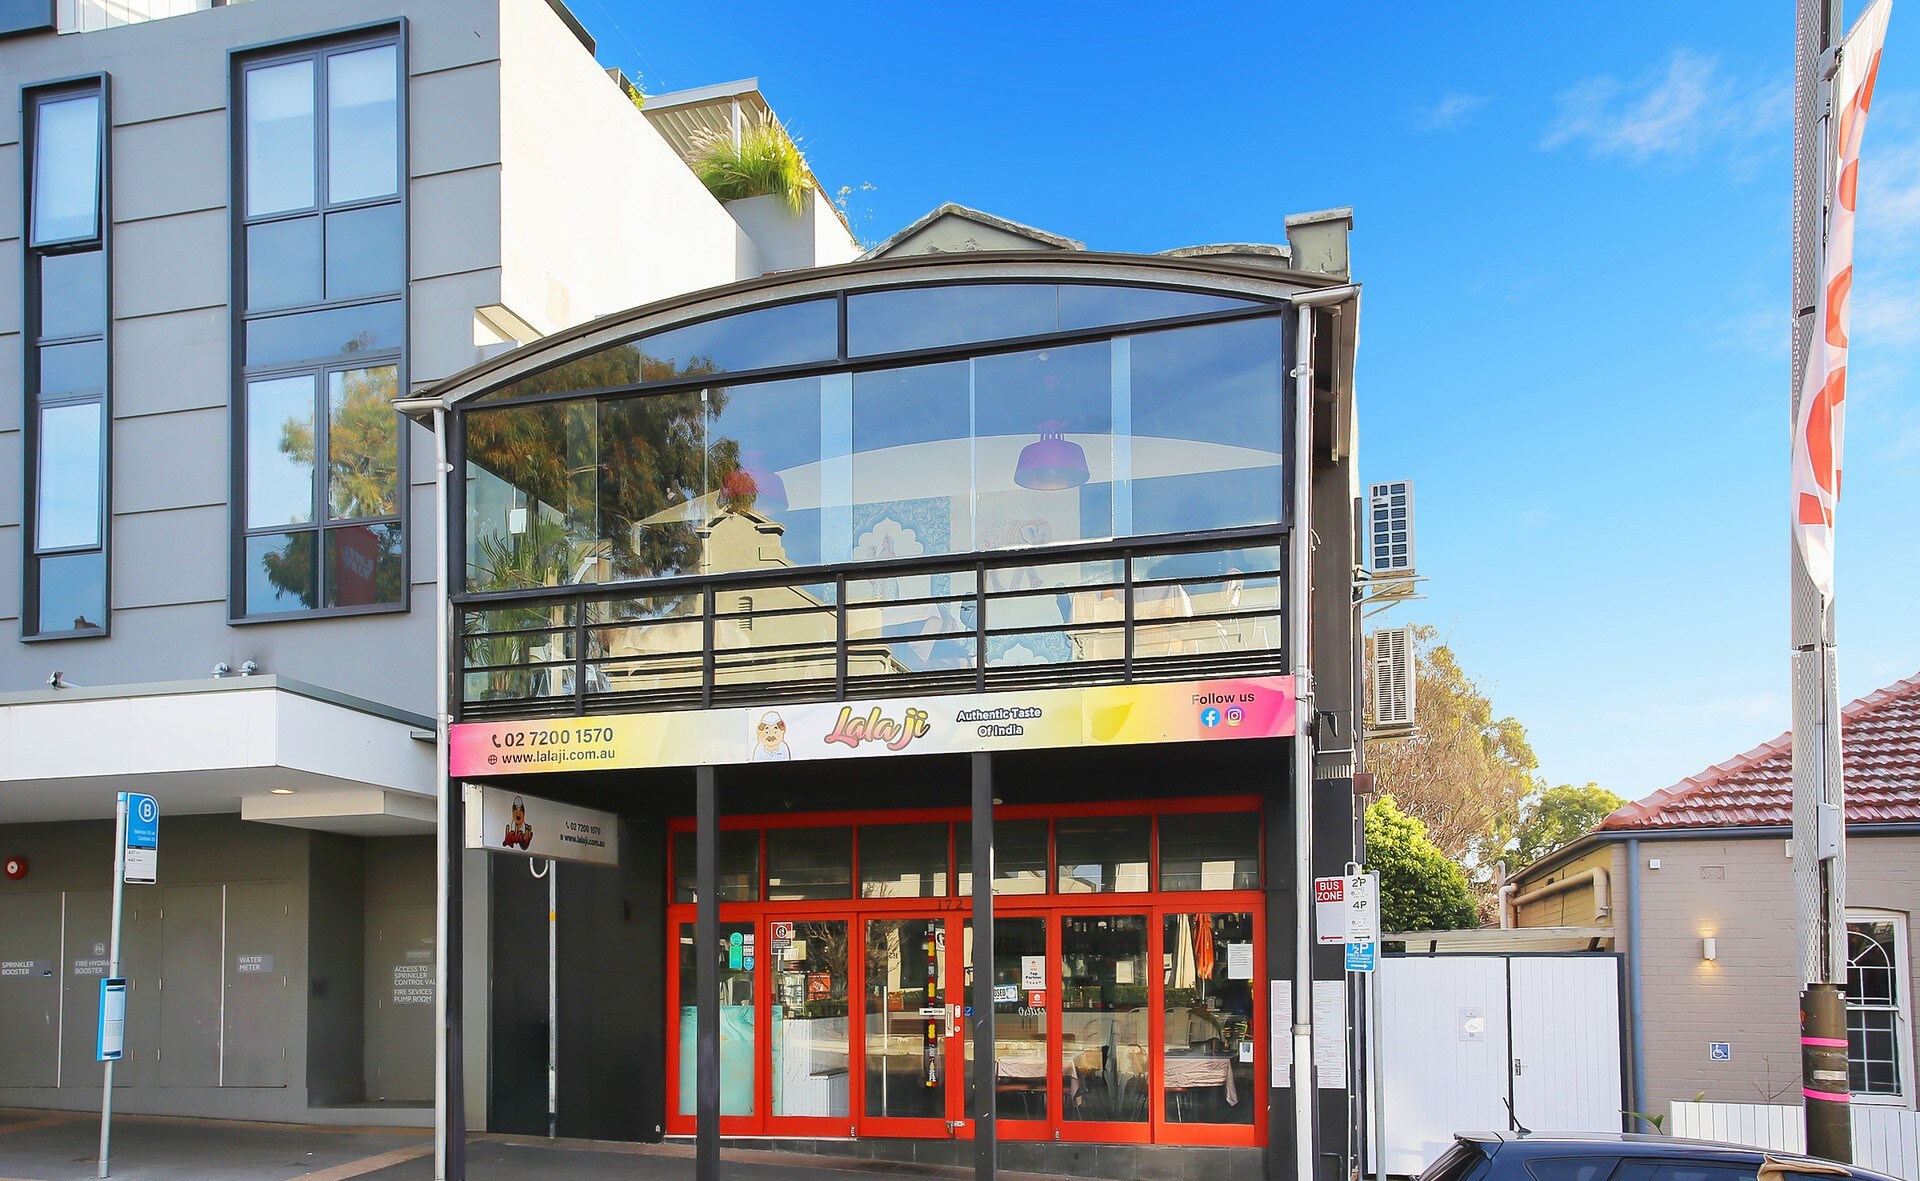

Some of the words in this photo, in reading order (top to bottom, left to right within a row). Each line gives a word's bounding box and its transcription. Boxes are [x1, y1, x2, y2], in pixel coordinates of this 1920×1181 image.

[1191, 693, 1236, 706] Follow
[1240, 693, 1255, 703] us
[956, 709, 1010, 723] Authentic
[1010, 706, 1042, 720] Taste
[977, 724, 993, 738] Of
[993, 723, 1024, 737] India
[504, 732, 525, 747] 02
[529, 729, 570, 746] 7200
[575, 727, 614, 743] 1570
[502, 749, 615, 764] www.lalaji.com.au
[143, 803, 152, 818] B
[570, 821, 577, 831] 02
[577, 823, 589, 833] 7200
[590, 825, 602, 835] 1570
[1319, 881, 1340, 891] BUS
[1352, 878, 1367, 888] 2P
[1317, 891, 1343, 902] ZONE
[937, 899, 964, 910] 172
[1352, 900, 1368, 910] 4P
[2, 961, 34, 969] SPRINKLER
[74, 967, 103, 975] BOOSTER
